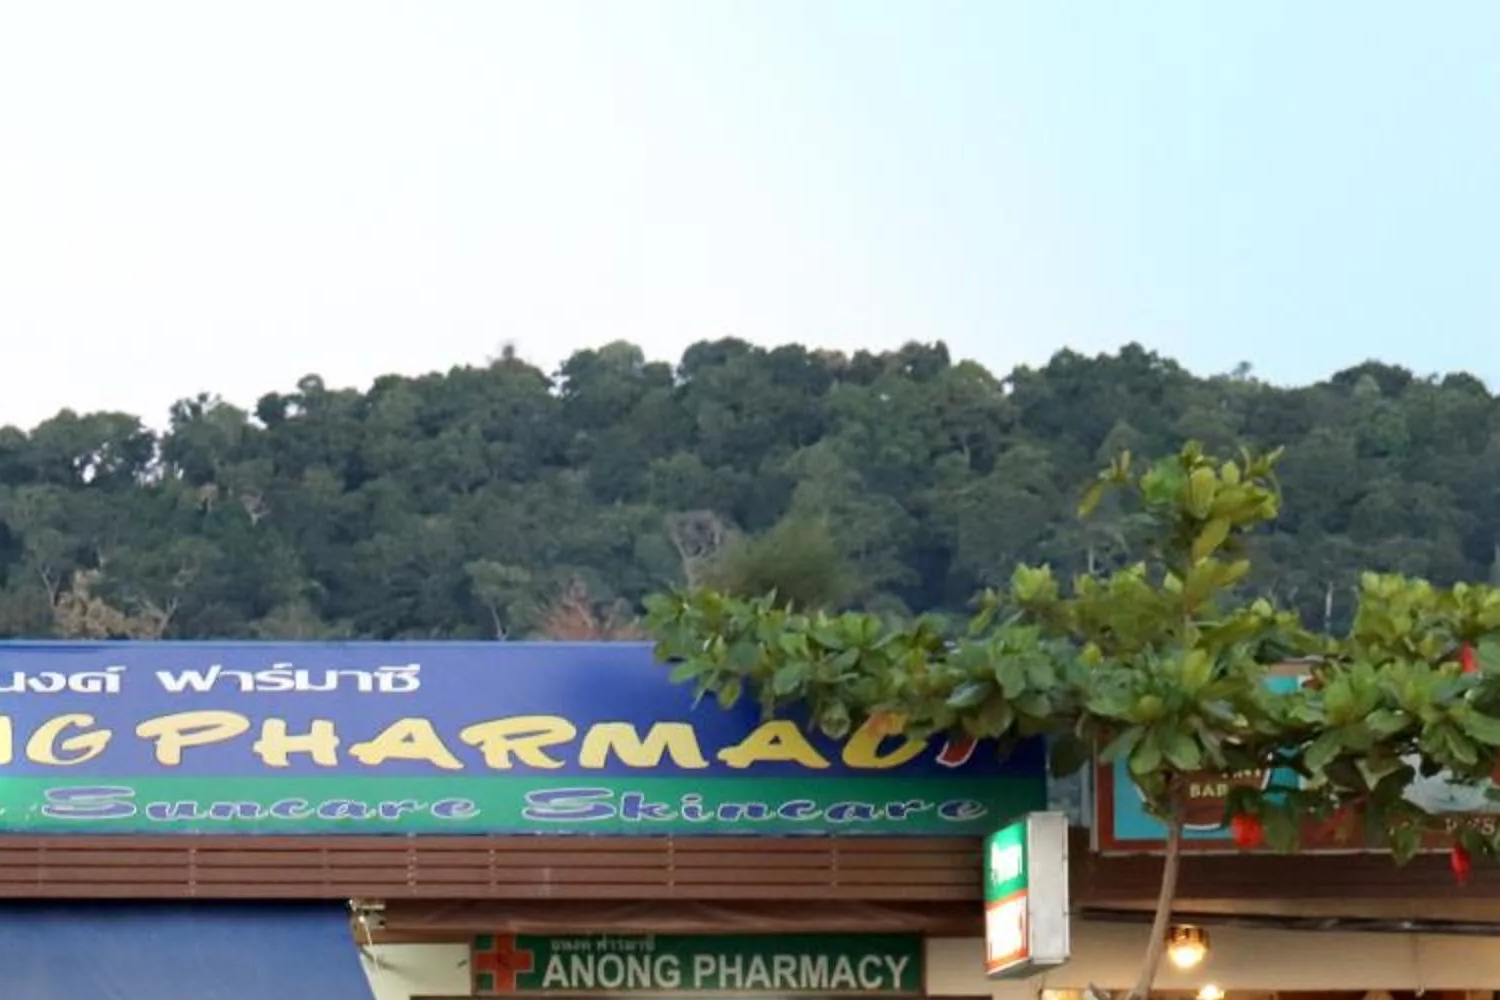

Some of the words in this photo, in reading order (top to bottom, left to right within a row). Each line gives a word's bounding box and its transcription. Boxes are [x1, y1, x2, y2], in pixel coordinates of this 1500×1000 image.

[41, 785, 481, 821] Suncare
[521, 787, 988, 822] Skincare
[542, 953, 680, 989] ANONG
[693, 953, 909, 989] PHARMACY
